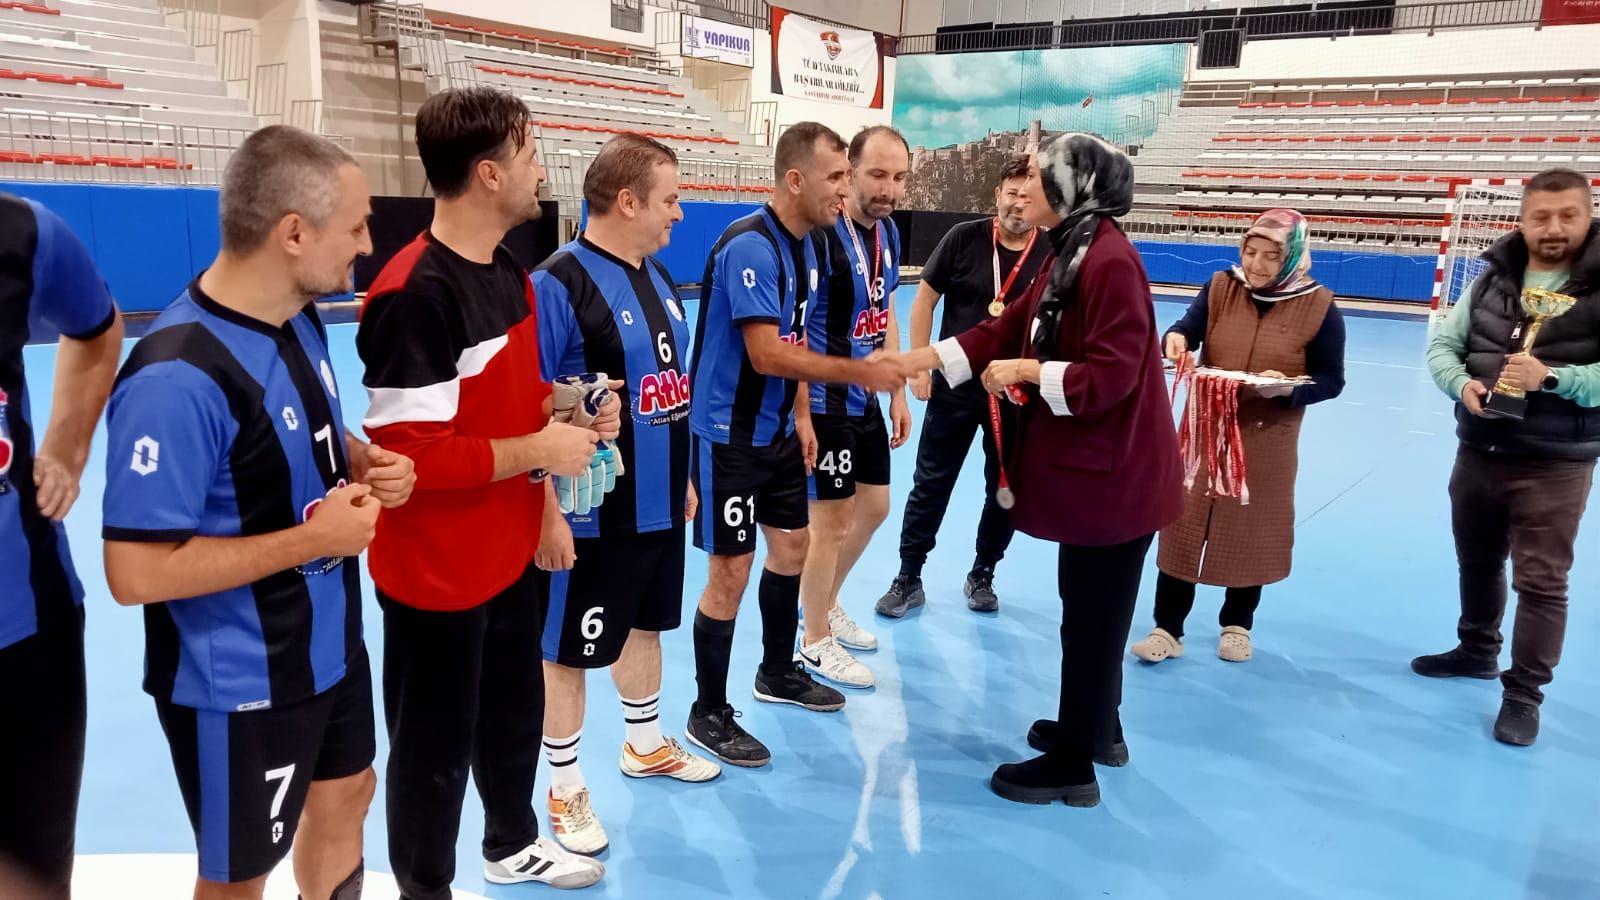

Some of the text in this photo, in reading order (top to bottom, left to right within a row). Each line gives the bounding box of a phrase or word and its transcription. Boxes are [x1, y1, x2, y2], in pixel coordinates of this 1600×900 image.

[704, 30, 750, 52] YAPIKUR
[657, 331, 673, 364] 6
[314, 423, 338, 475] 7
[819, 449, 852, 476] 48
[723, 495, 755, 528] 61
[580, 606, 605, 640] 6
[265, 763, 296, 820] 7
